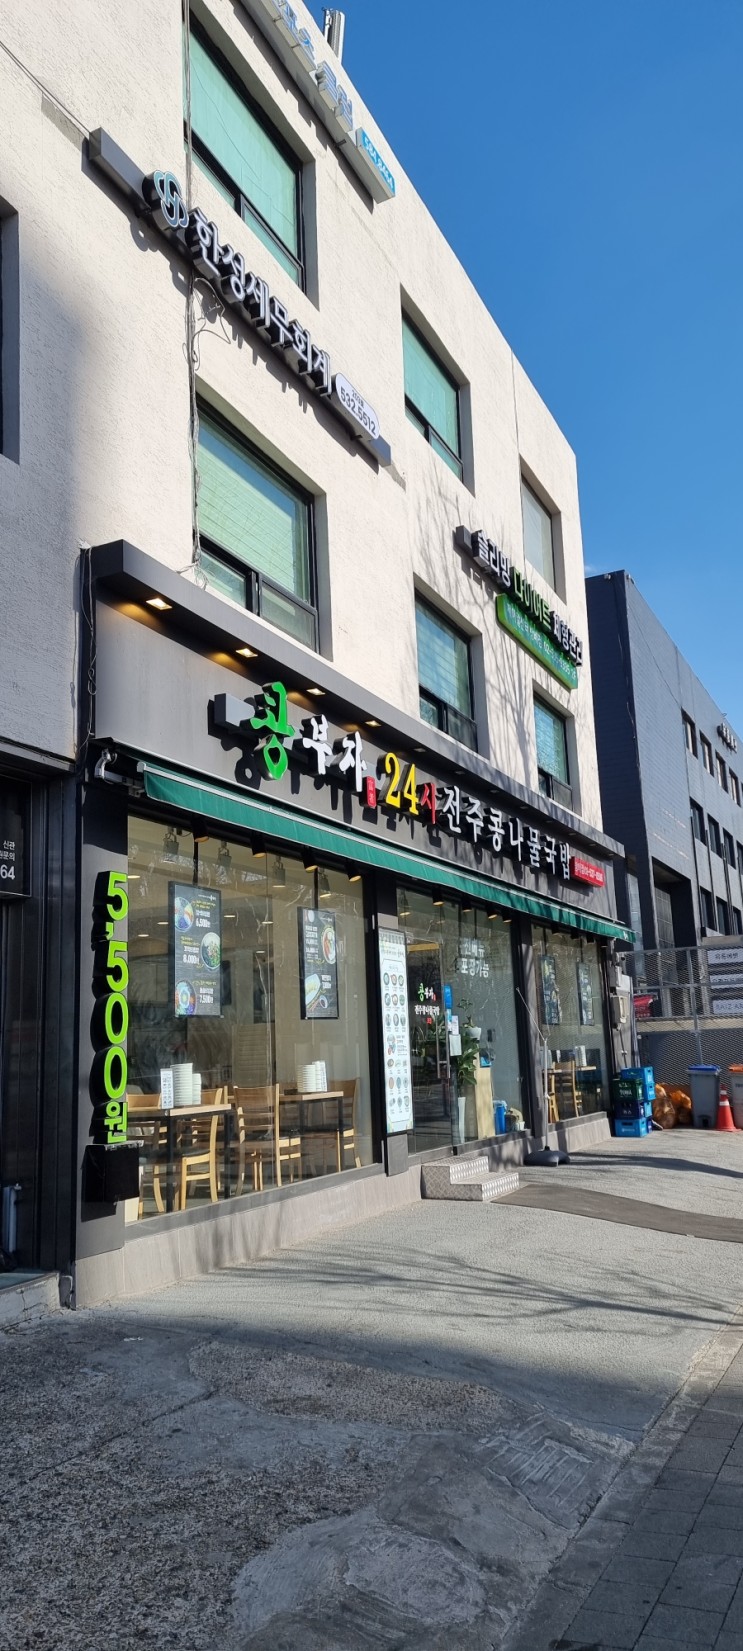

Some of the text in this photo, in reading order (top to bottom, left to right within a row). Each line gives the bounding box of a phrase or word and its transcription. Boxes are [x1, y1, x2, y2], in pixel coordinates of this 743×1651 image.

[195, 212, 332, 395] 한성세무회계
[477, 529, 512, 588] 슬리밍
[513, 570, 553, 630] 다이어트
[552, 611, 583, 667] 체형관리
[250, 681, 572, 881] 콩부자 24시 전주콩나물국밥
[104, 870, 129, 1144] 5,500원
